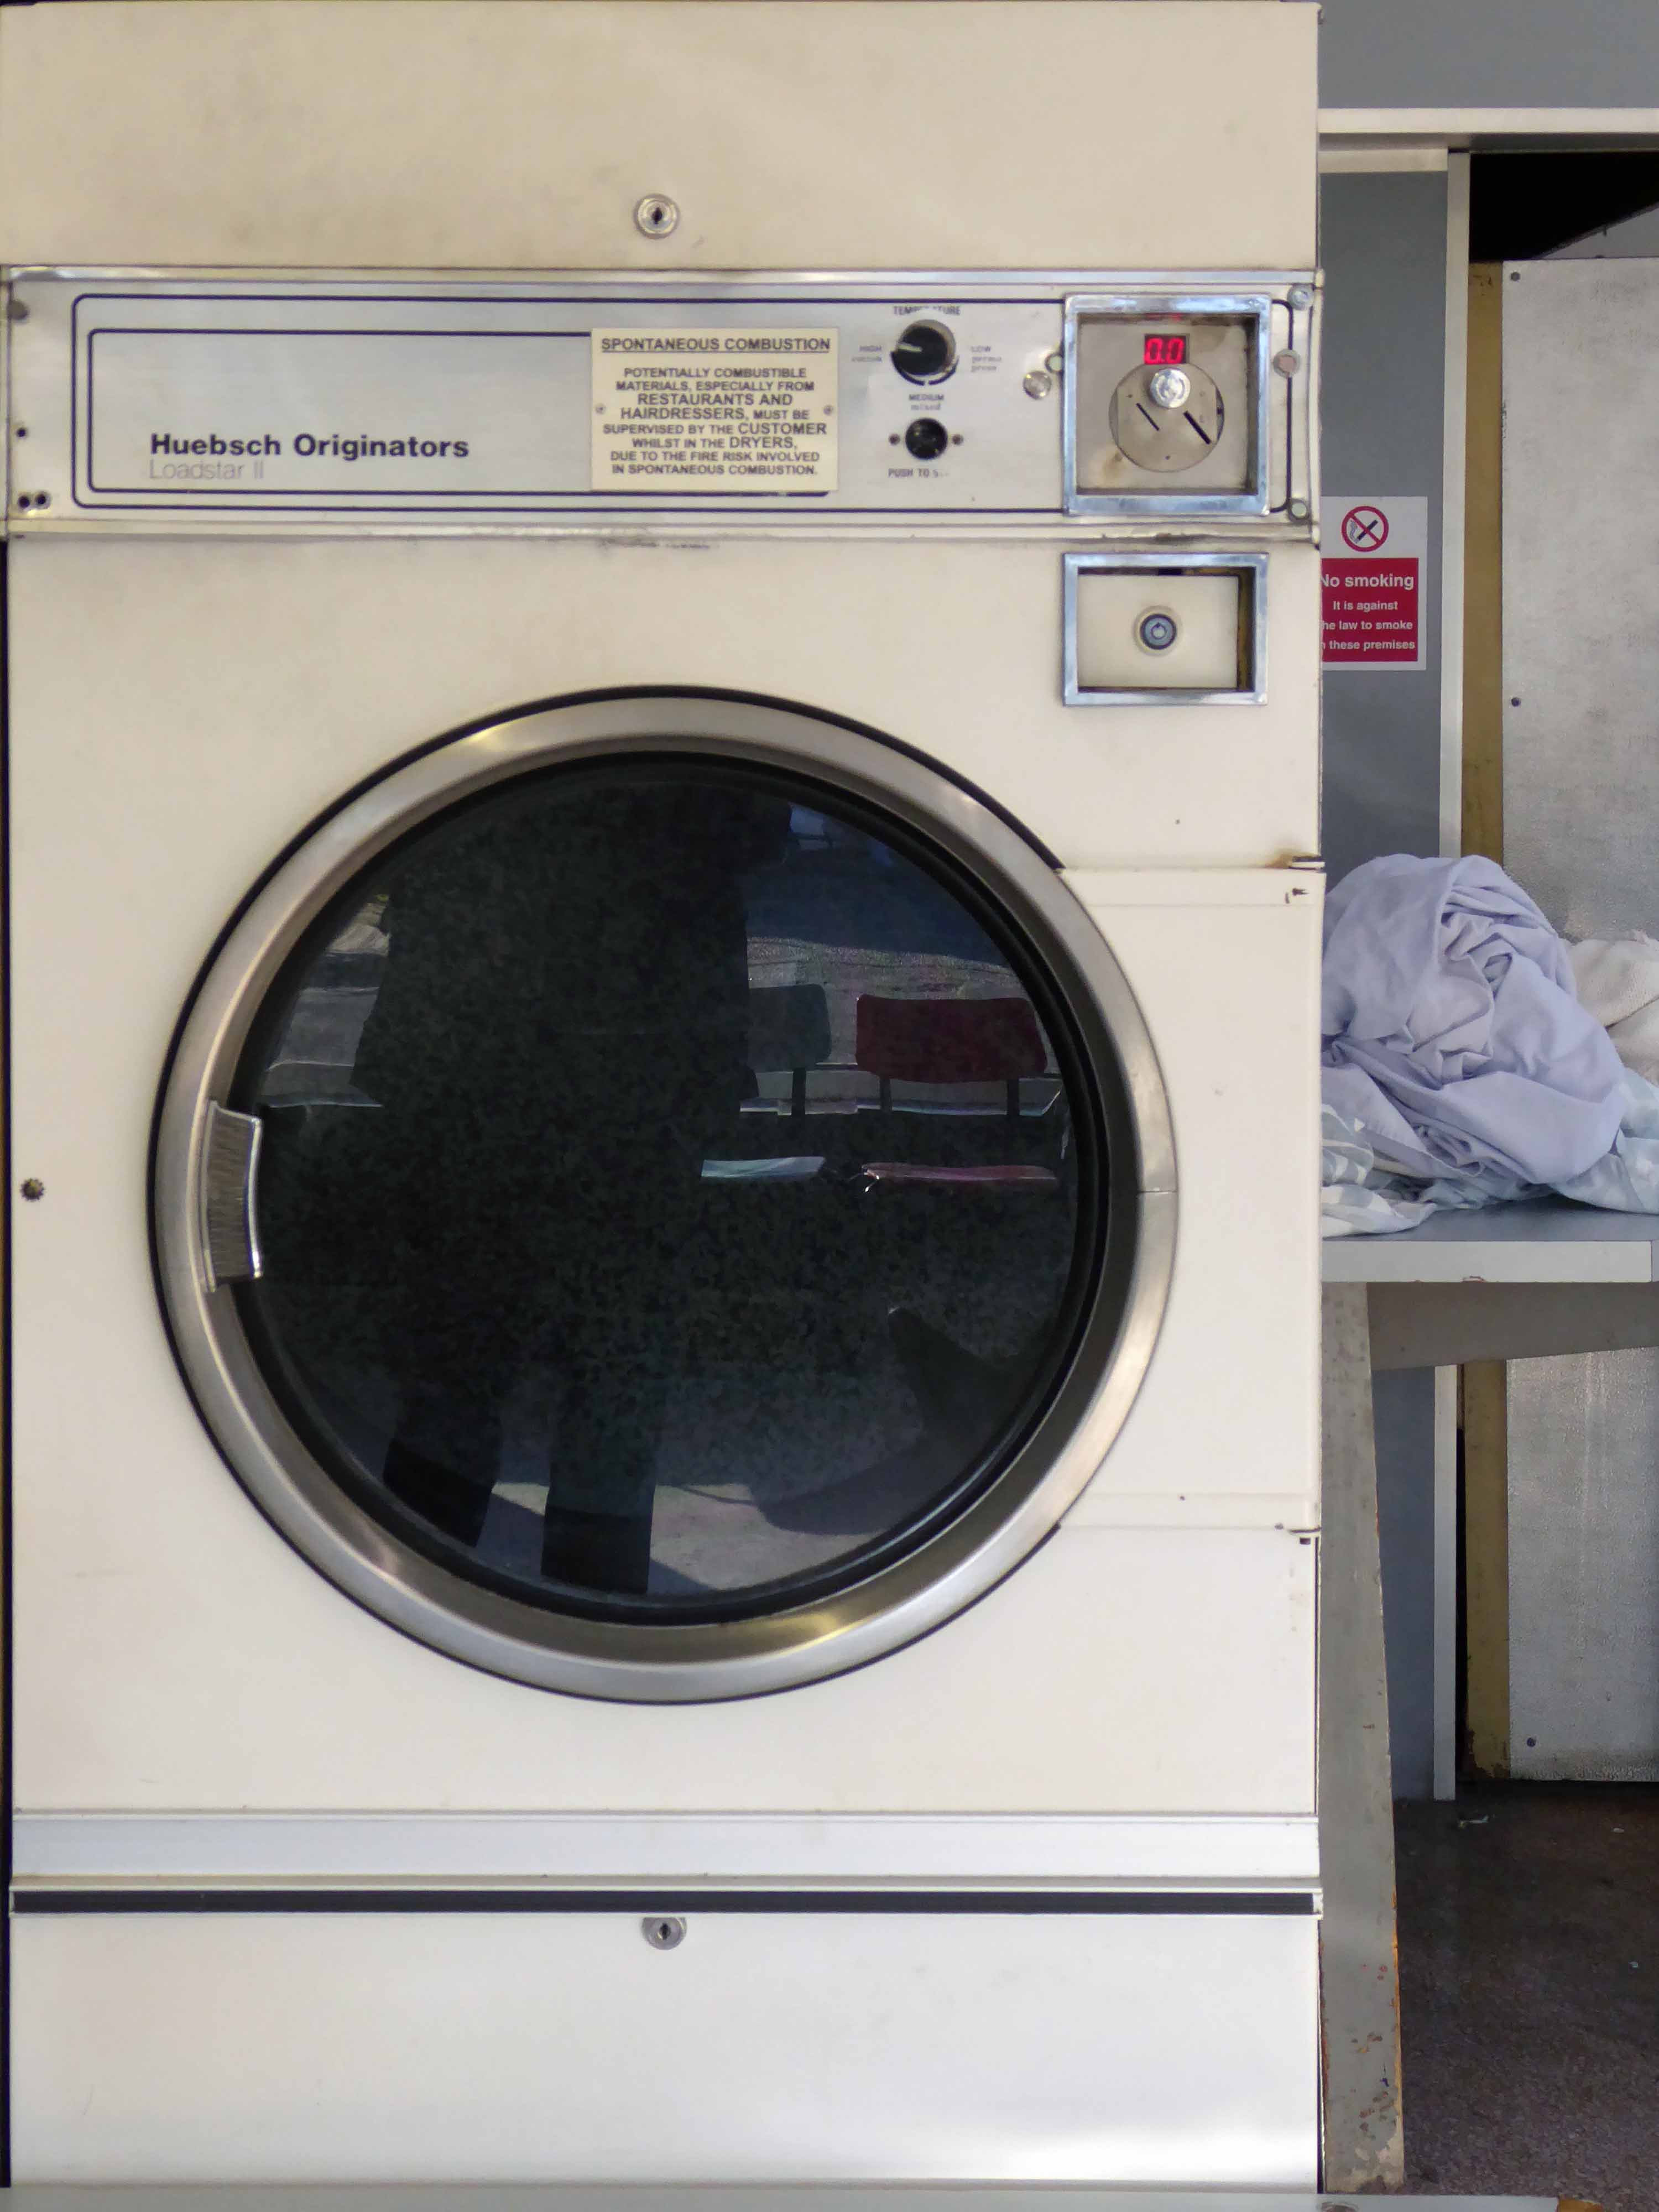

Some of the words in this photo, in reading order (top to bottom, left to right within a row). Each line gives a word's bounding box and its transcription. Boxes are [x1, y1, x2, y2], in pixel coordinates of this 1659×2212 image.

[602, 338, 719, 350] SPONTANEOUS
[725, 338, 830, 350] COMBUSTION
[624, 368, 709, 378] POTENTIALLY
[714, 368, 806, 378] COMBUSTIBLE
[696, 381, 773, 391] ESPECIALLY
[778, 381, 815, 391] FROM
[638, 394, 753, 405] RESTAURANTS
[759, 394, 792, 405] AND
[620, 408, 748, 420] HAIRDRESSERS,
[753, 410, 787, 420] MUST
[793, 410, 809, 420] BE
[603, 424, 684, 435] SUPERVISED
[688, 424, 705, 435] BY
[709, 424, 733, 435] THE
[738, 424, 827, 434] CUSTOMER
[151, 434, 281, 456] Huebsch
[293, 434, 469, 461] Originators
[632, 438, 680, 448] WHILST
[684, 438, 696, 448] IN
[701, 438, 724, 448] THE
[730, 437, 797, 449] DRYERS,
[611, 452, 636, 461] DUE
[642, 452, 657, 461] TO
[664, 452, 686, 461] THE
[691, 452, 718, 461] FIRE
[723, 452, 752, 461] RISK
[757, 452, 819, 461] INVOLVED
[149, 460, 244, 479] Loadstar
[612, 465, 624, 475] IN
[629, 465, 724, 475] SPONTANEOUS
[888, 468, 912, 477] PUSH
[918, 468, 929, 477] TO
[1321, 574, 1339, 587] No
[1345, 573, 1414, 590] smoking
[1333, 601, 1340, 610] It
[1344, 601, 1353, 610] is
[1357, 601, 1398, 612] against
[1319, 620, 1335, 630] he
[1339, 620, 1358, 630] law
[1361, 620, 1373, 630] to
[1375, 620, 1412, 630] smoke
[1329, 640, 1360, 649] these
[1363, 640, 1415, 651] premises
